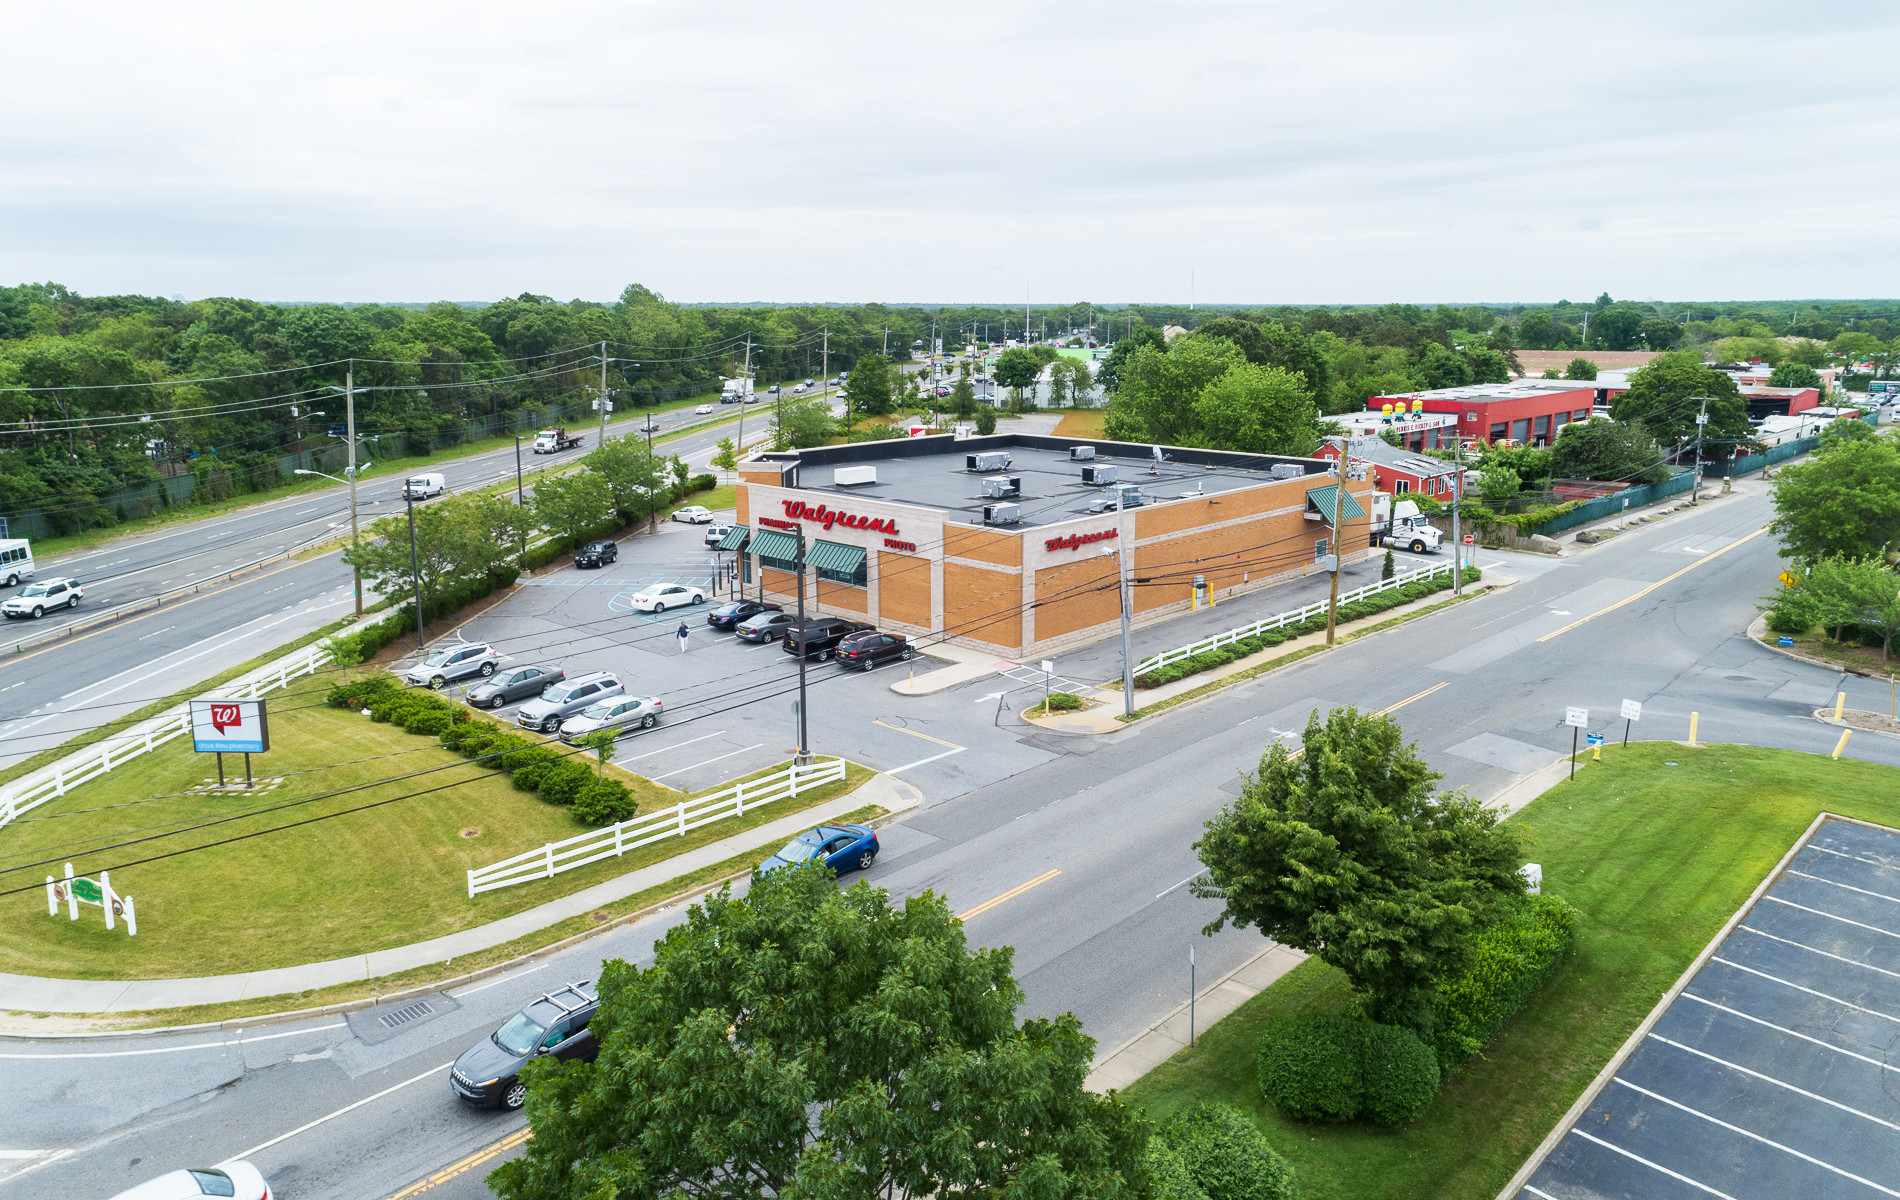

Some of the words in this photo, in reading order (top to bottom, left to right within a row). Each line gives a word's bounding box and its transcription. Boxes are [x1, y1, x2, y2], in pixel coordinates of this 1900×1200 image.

[758, 516, 800, 530] PHARMACY
[782, 500, 899, 535] Walgreens
[884, 538, 916, 552] PHOTO
[1045, 528, 1119, 552] Walgreens
[229, 743, 260, 751] pharmacy
